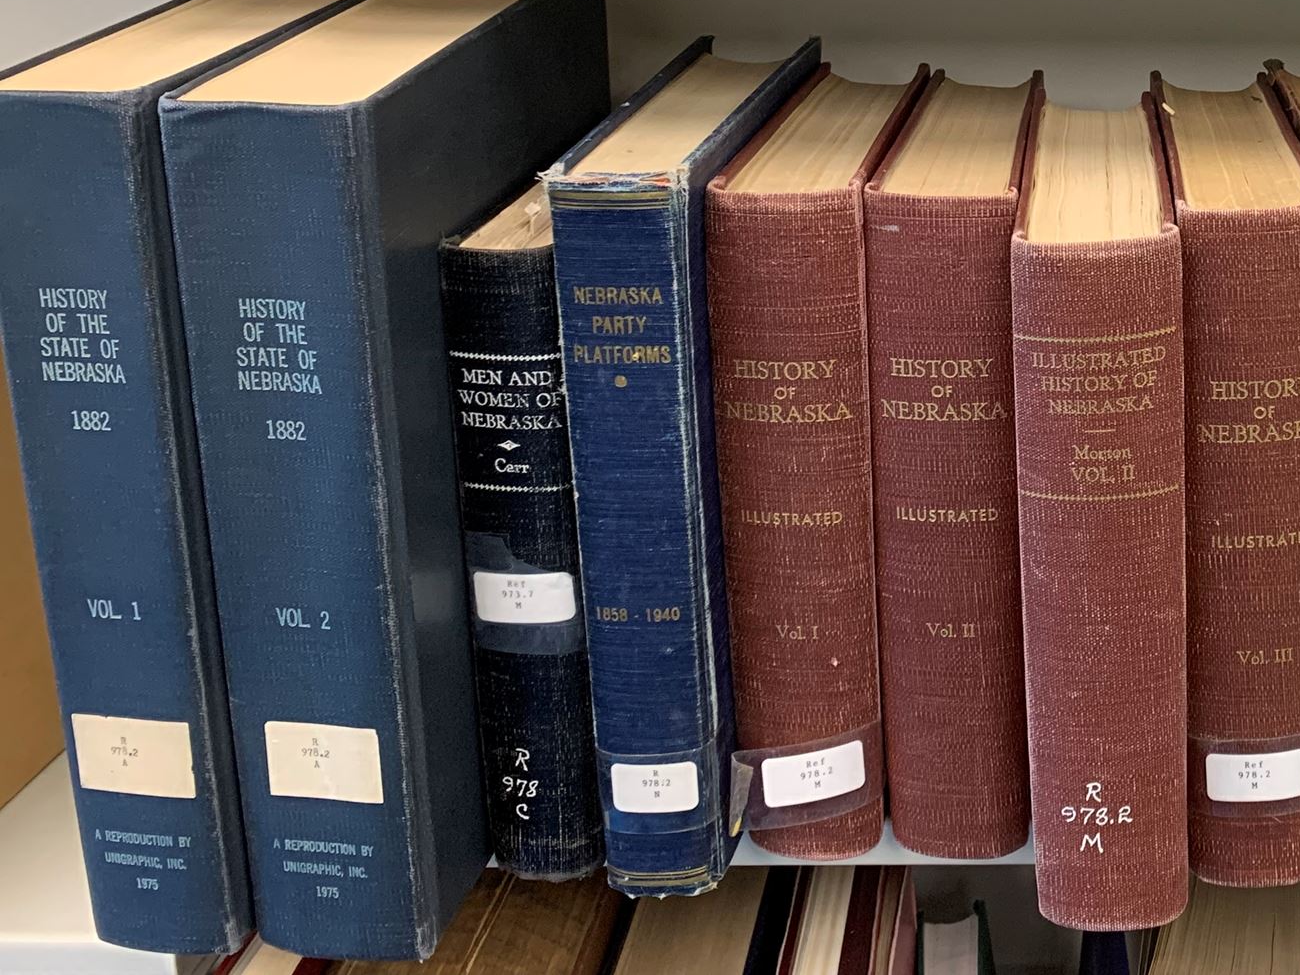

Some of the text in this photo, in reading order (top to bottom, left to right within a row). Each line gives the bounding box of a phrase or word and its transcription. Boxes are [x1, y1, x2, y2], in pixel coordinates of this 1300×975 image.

[39, 287, 108, 310] HISTORY
[573, 286, 664, 305] NEBRASKA
[238, 298, 306, 321] HISTORY
[592, 315, 647, 335] PARTY
[40, 338, 120, 359] STATE OF
[236, 347, 317, 370] STATE OF
[573, 345, 671, 364] PLATFORMS
[1031, 345, 1166, 369] ILLUSTRATED
[42, 362, 126, 384] NEBRASKA
[733, 359, 836, 381] HISTORY
[890, 356, 993, 380] HISTORY
[238, 371, 322, 395] NEBRASKA
[725, 402, 854, 424] NEBRASKA
[881, 399, 1008, 421] NEBRASKA
[1048, 394, 1154, 416] NEBRASKA
[1253, 404, 1275, 420] OF
[70, 410, 112, 431] 1882
[266, 420, 307, 441] 1882
[461, 411, 563, 430] NEBRASKA
[740, 509, 843, 527] ILLUSTRATED
[110, 746, 139, 757] 978.2
[301, 748, 330, 759] 978.2
[806, 758, 826, 769] Ref
[641, 778, 672, 789] 978.2
[1238, 770, 1271, 780] 978.2
[1061, 805, 1134, 825] 978.2
[274, 838, 374, 857] A REPRODUCTION BY
[136, 878, 159, 890] 1975
